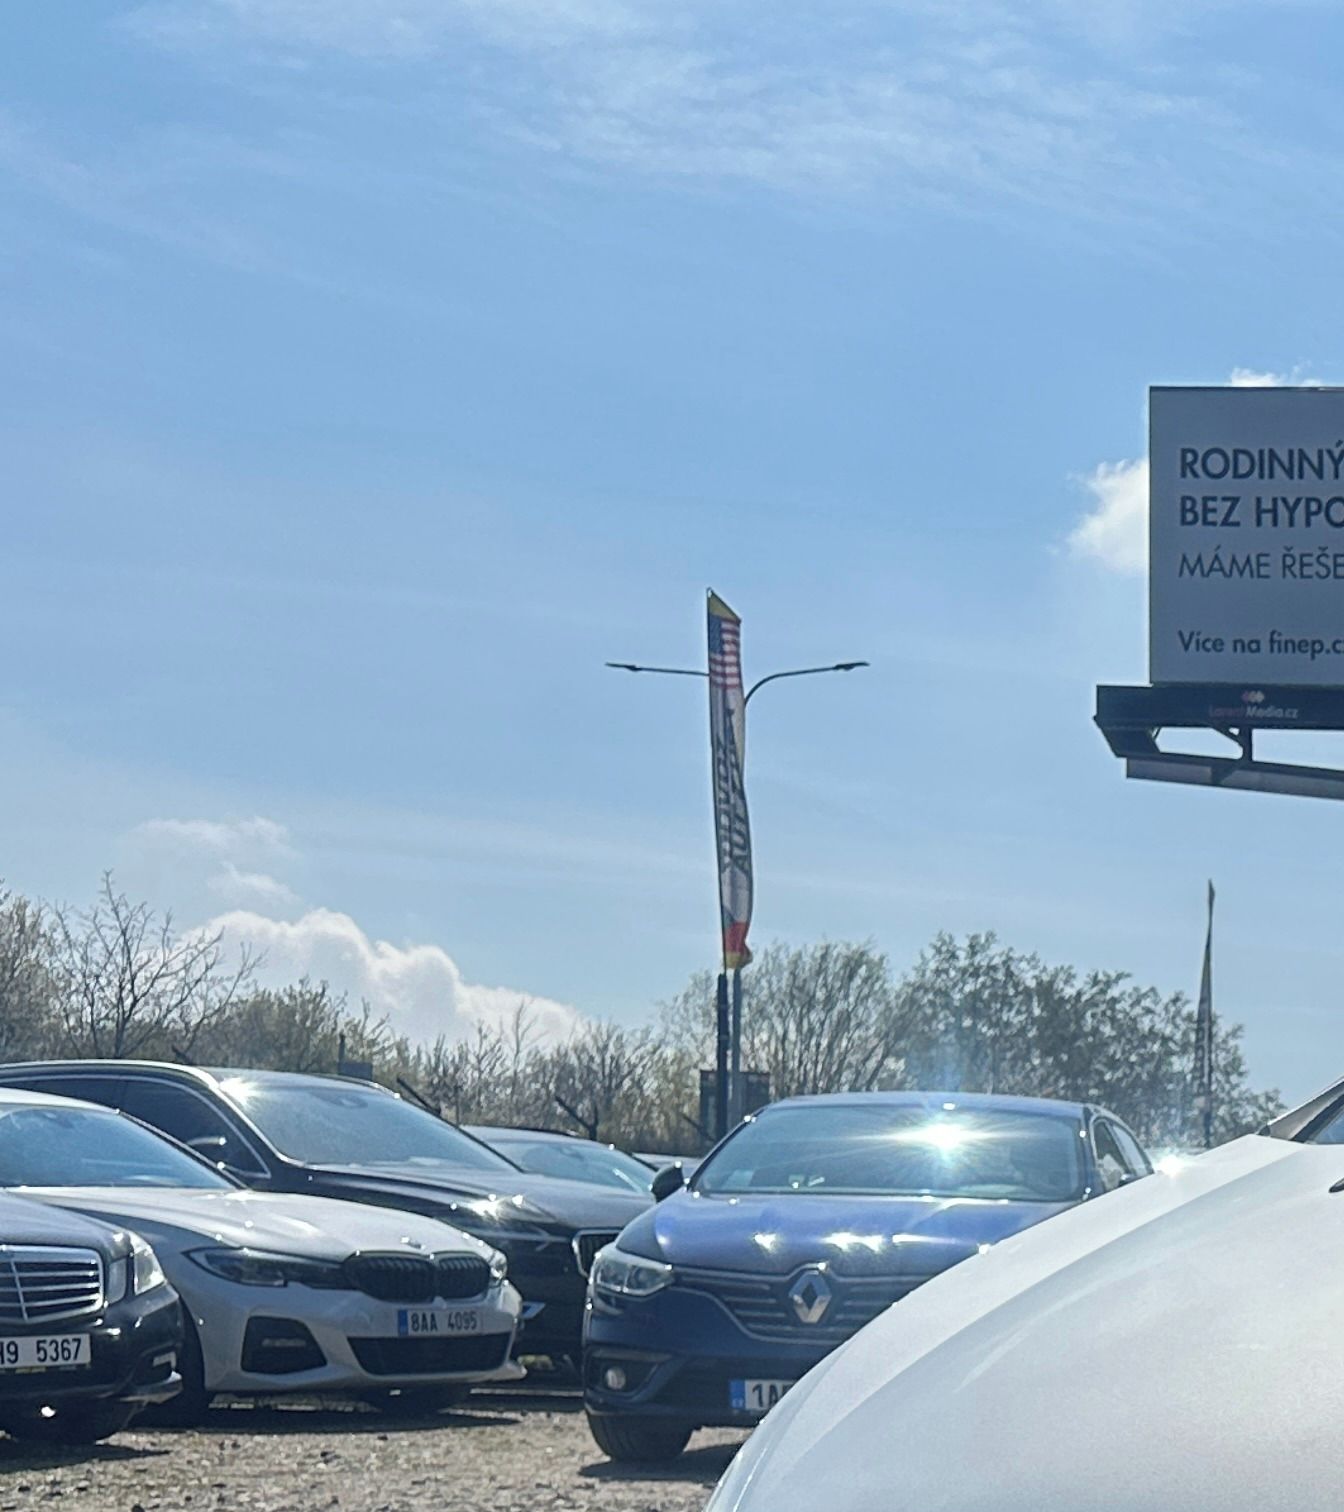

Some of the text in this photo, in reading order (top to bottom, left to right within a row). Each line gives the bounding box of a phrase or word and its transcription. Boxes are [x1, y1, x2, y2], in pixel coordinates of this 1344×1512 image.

[1180, 496, 1241, 527] BEZ
[1179, 545, 1270, 579] MÁME
[1232, 638, 1260, 654] na
[410, 1312, 438, 1332] 8AA
[36, 1338, 81, 1362] 5367
[752, 1383, 795, 1408] 1A
